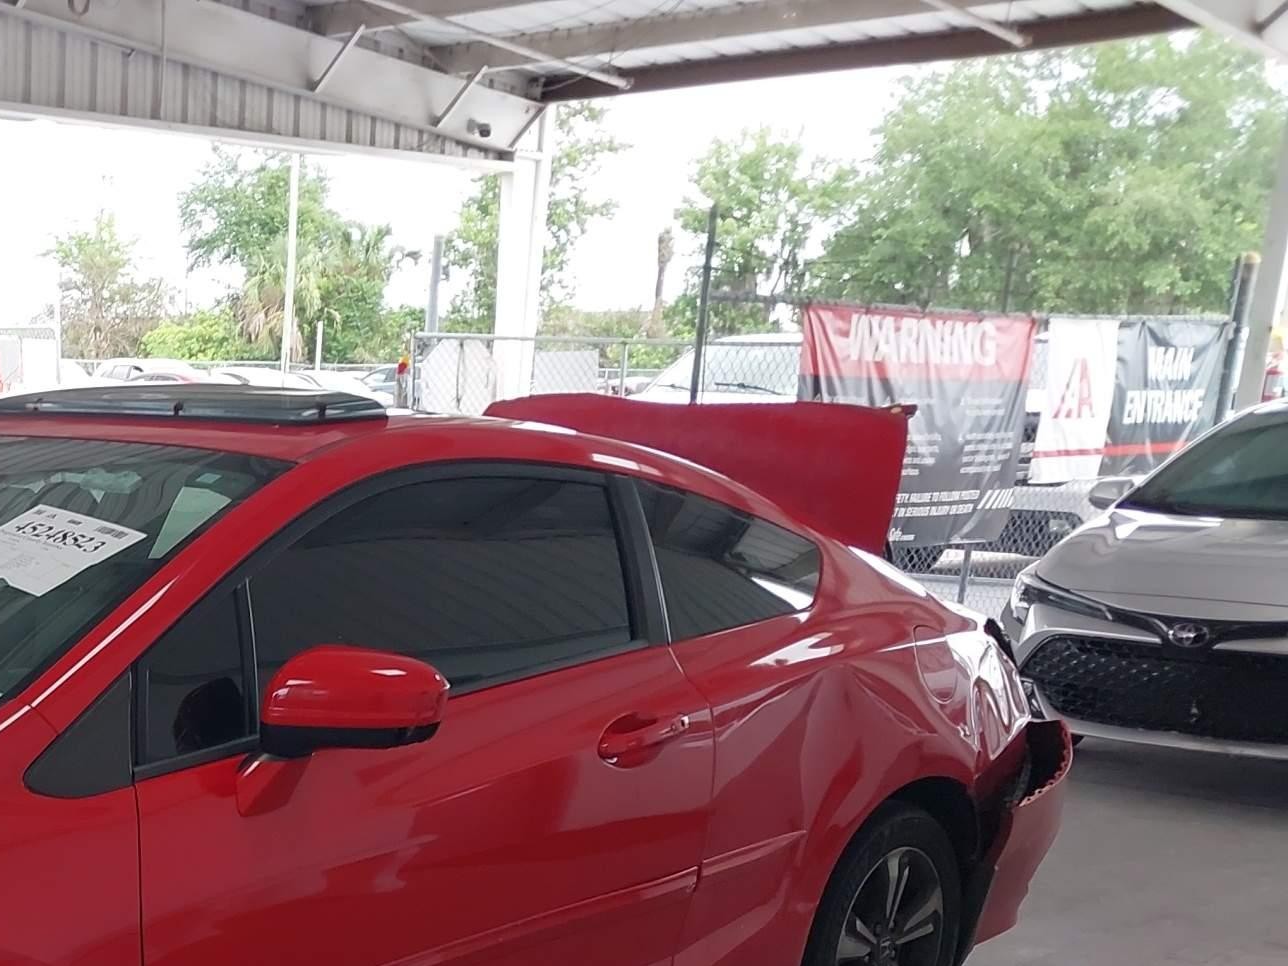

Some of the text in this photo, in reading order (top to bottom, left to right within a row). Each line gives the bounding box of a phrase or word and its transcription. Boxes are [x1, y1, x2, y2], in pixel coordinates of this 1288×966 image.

[849, 314, 997, 366] WARNING
[1148, 347, 1194, 380] MAIN
[1122, 389, 1204, 424] ENTRANCE
[15, 521, 106, 552] 45248523
